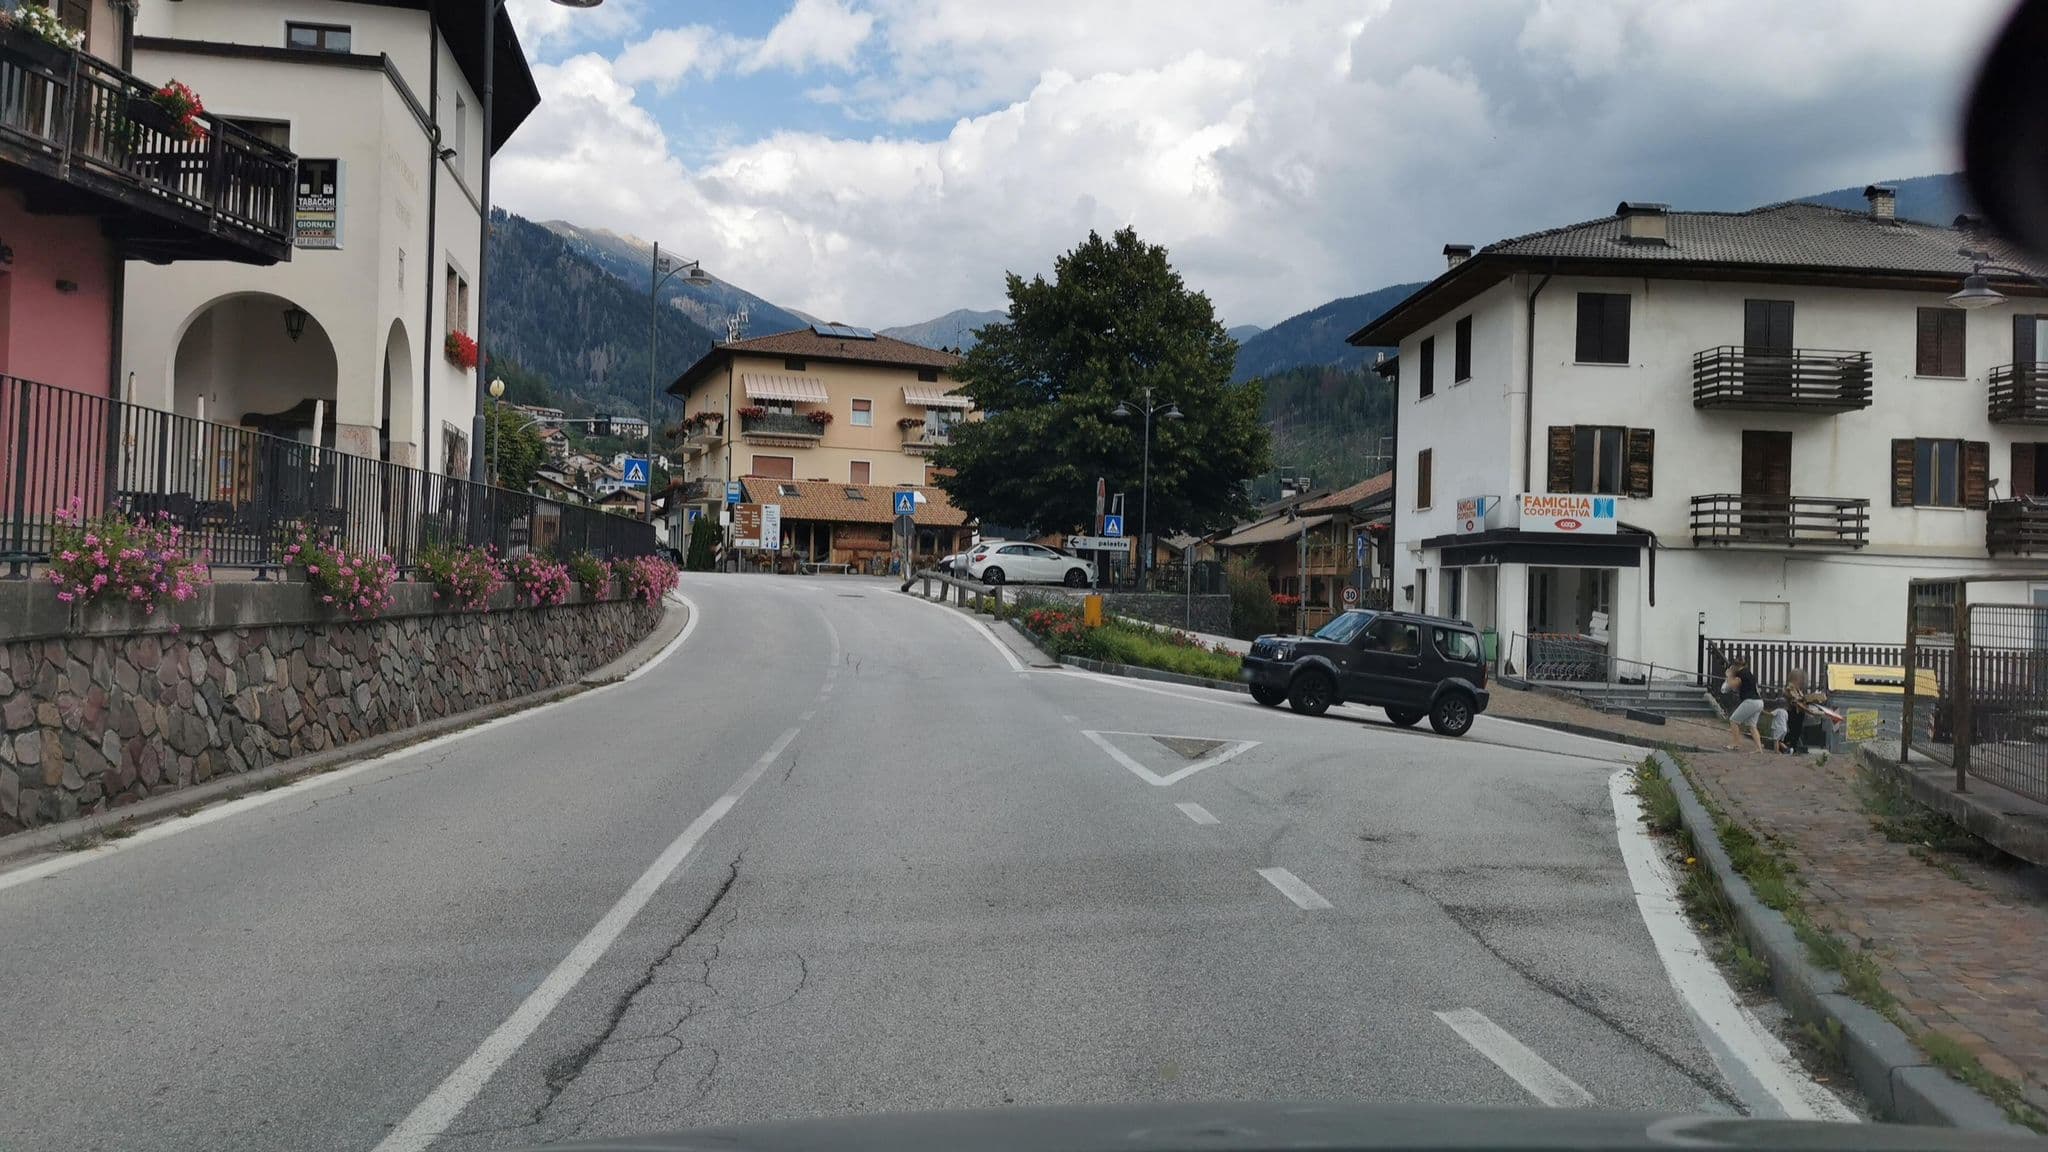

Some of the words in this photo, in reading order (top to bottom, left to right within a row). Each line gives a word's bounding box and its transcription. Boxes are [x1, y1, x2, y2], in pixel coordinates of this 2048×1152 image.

[298, 198, 335, 206] TABACCHI
[1524, 496, 1591, 509] FAMIGLIA
[1524, 507, 1590, 518] COOPERATIVA
[1560, 521, 1576, 529] coop
[1357, 537, 1363, 557] P
[1345, 591, 1356, 600] 30
